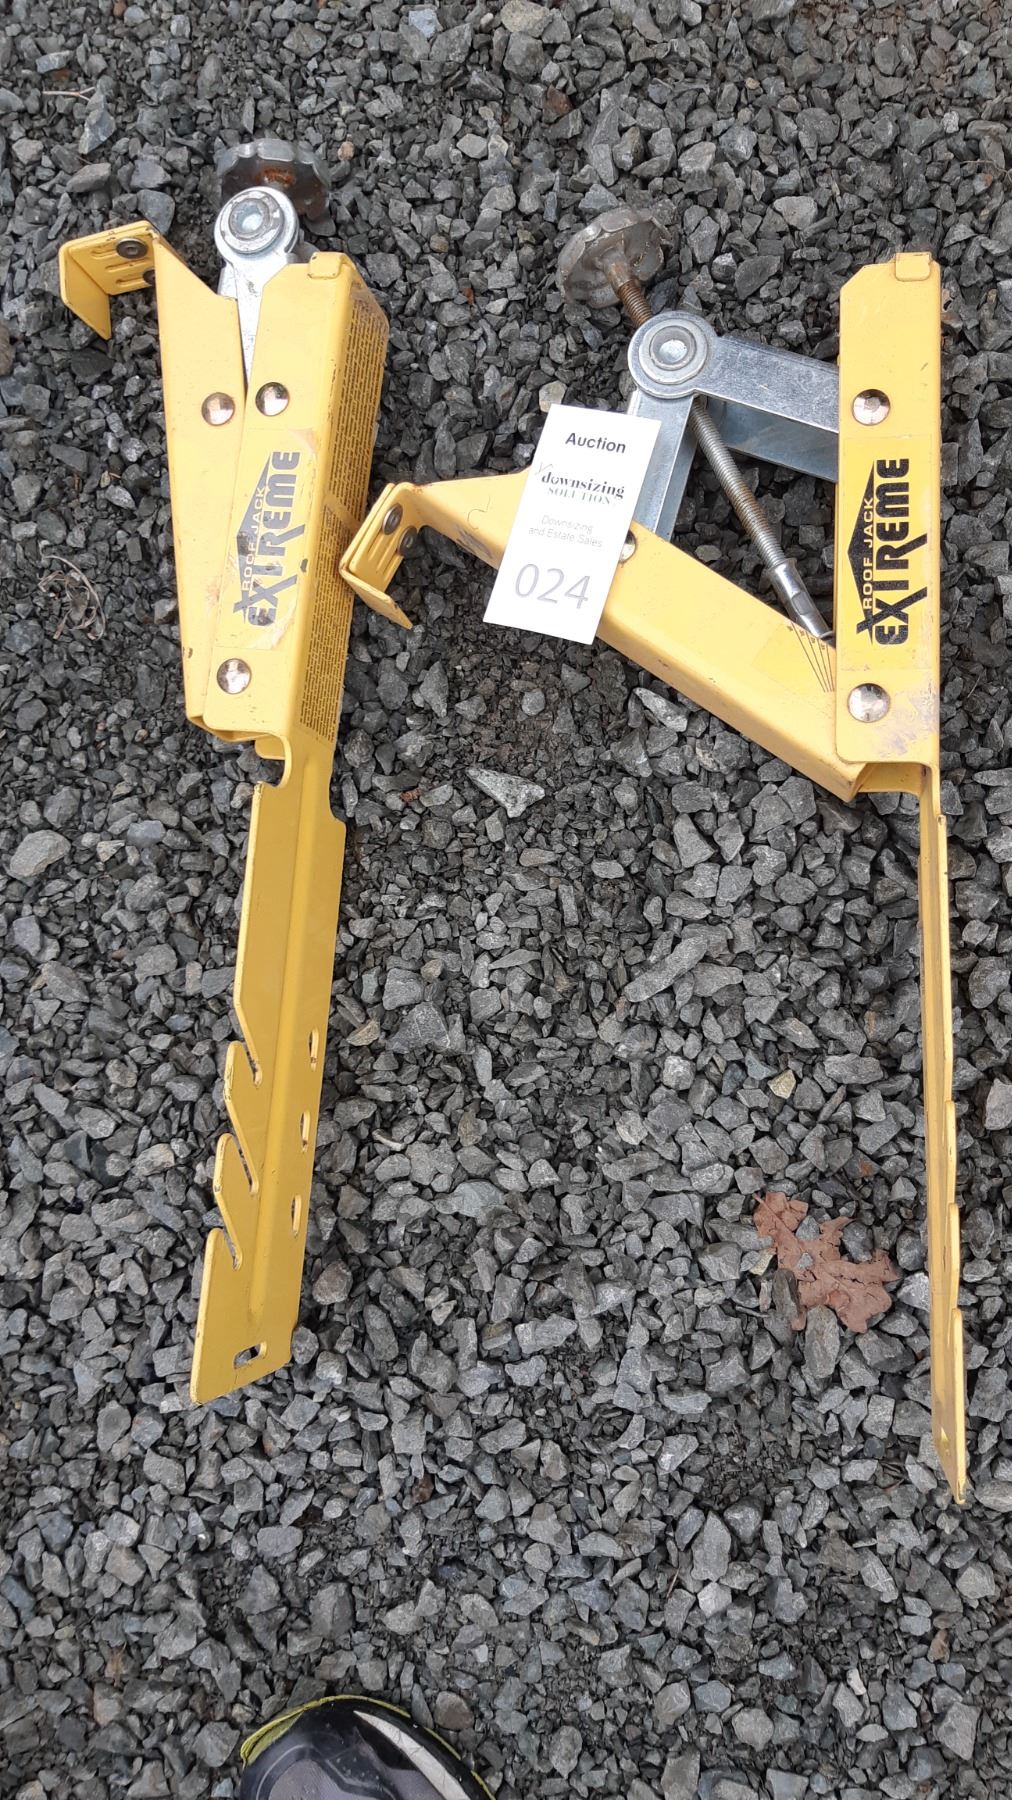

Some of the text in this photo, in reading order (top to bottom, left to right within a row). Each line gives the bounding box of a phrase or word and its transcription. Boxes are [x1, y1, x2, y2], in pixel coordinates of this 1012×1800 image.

[565, 432, 626, 454] Auction
[541, 471, 625, 500] downsizing
[241, 486, 266, 591] ROOF JACK
[541, 514, 593, 533] Downsizing
[546, 528, 575, 543] Estate
[577, 534, 604, 549] Sales
[856, 458, 928, 645] EXTREME
[863, 497, 873, 609] ROOF JACK
[515, 563, 591, 609] 024
